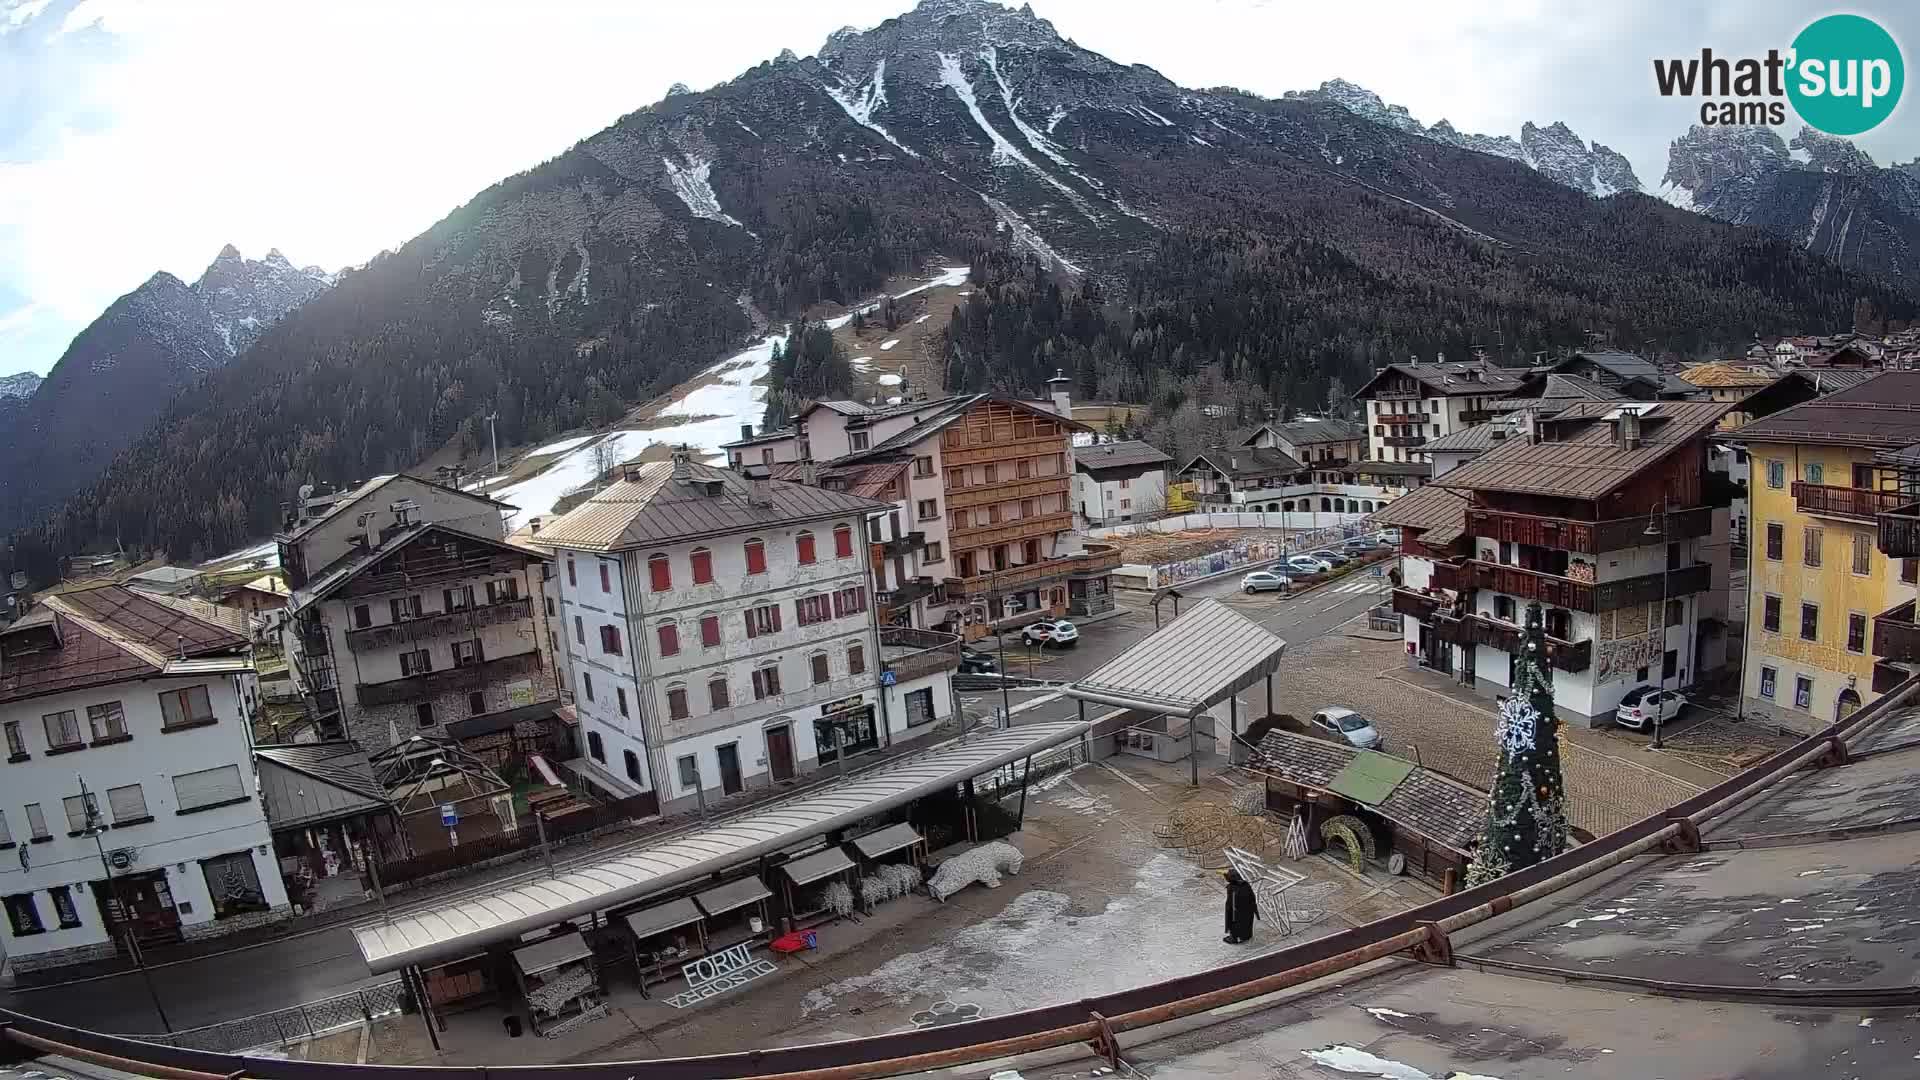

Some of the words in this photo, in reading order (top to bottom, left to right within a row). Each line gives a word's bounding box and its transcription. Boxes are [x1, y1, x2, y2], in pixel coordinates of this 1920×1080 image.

[682, 942, 754, 987] FORNI
[750, 960, 778, 980] DI
[662, 971, 750, 1009] SOPRA
